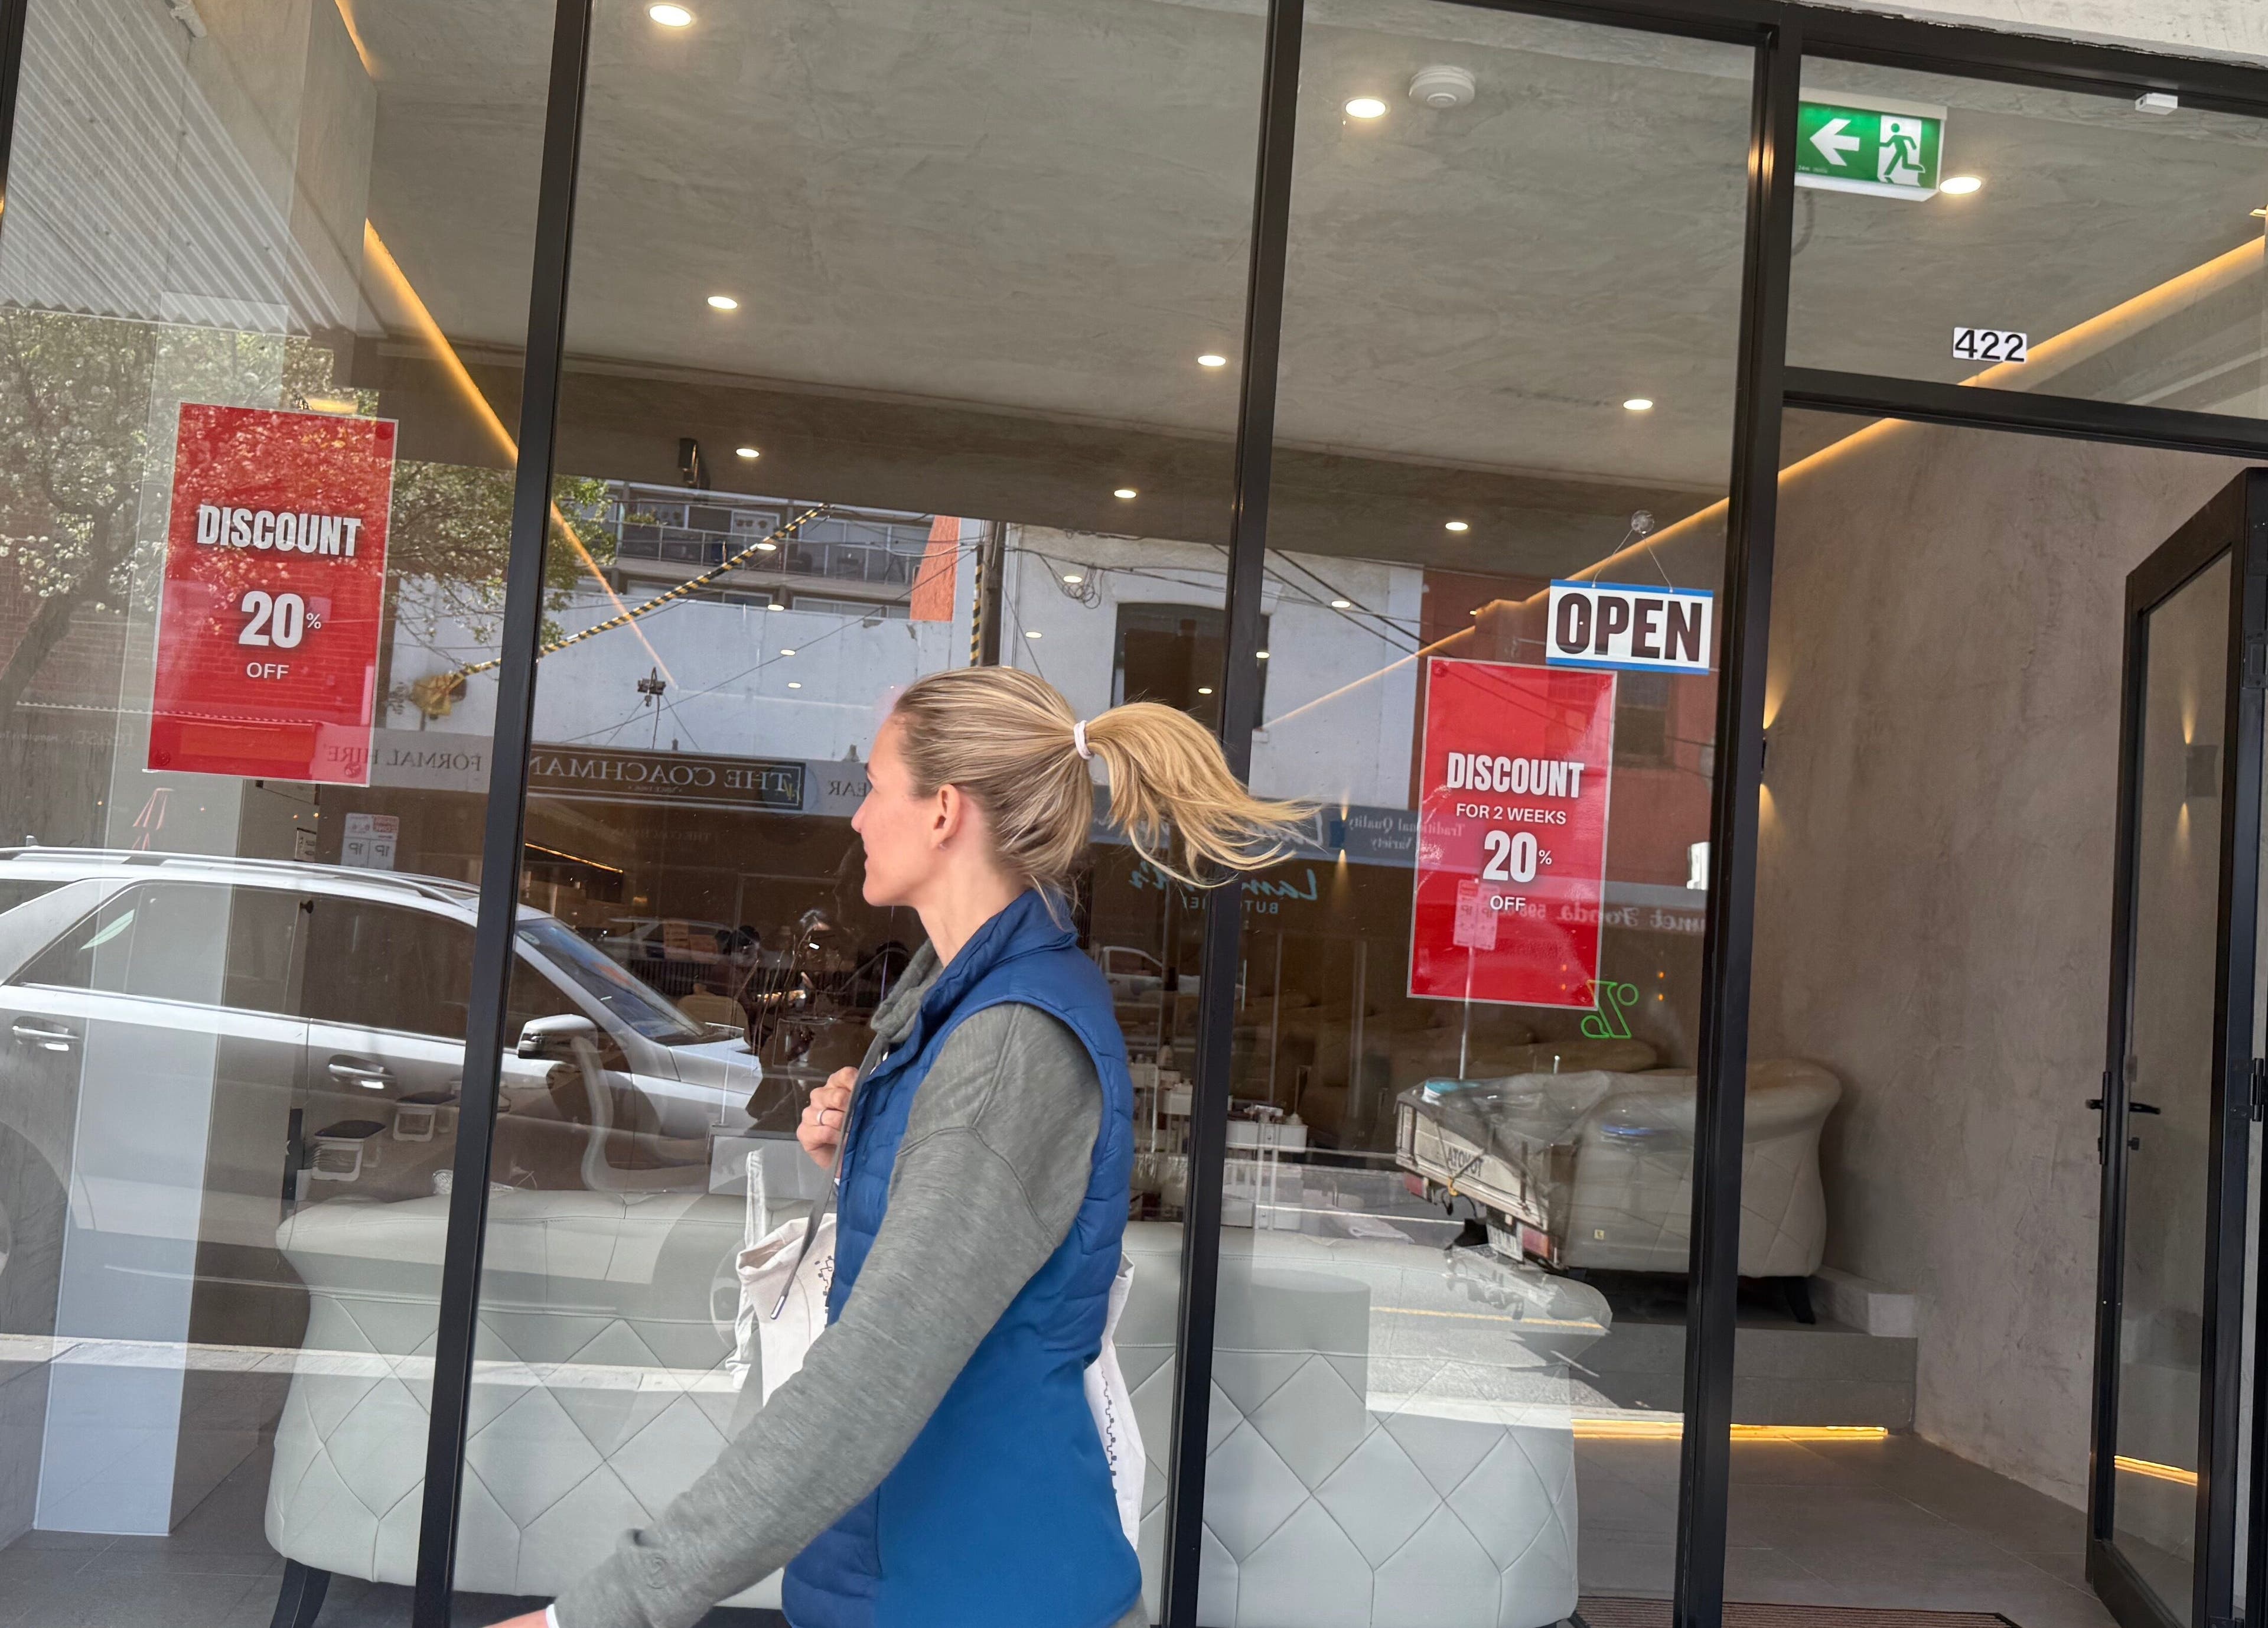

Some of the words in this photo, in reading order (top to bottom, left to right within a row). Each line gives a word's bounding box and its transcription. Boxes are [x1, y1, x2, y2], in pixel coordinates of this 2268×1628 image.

[1955, 330, 2025, 362] 422
[197, 504, 361, 556] DISCOUNT
[239, 591, 321, 648] 20%
[1556, 593, 1702, 662] OPEN
[246, 662, 289, 679] OFF
[1447, 752, 1584, 797] DISCOUNT
[1456, 803, 1489, 819] FOR
[1493, 806, 1503, 819] 2
[1507, 807, 1566, 825] WEEKS
[1483, 830, 1552, 883] 20%
[1490, 896, 1526, 911] OFF
